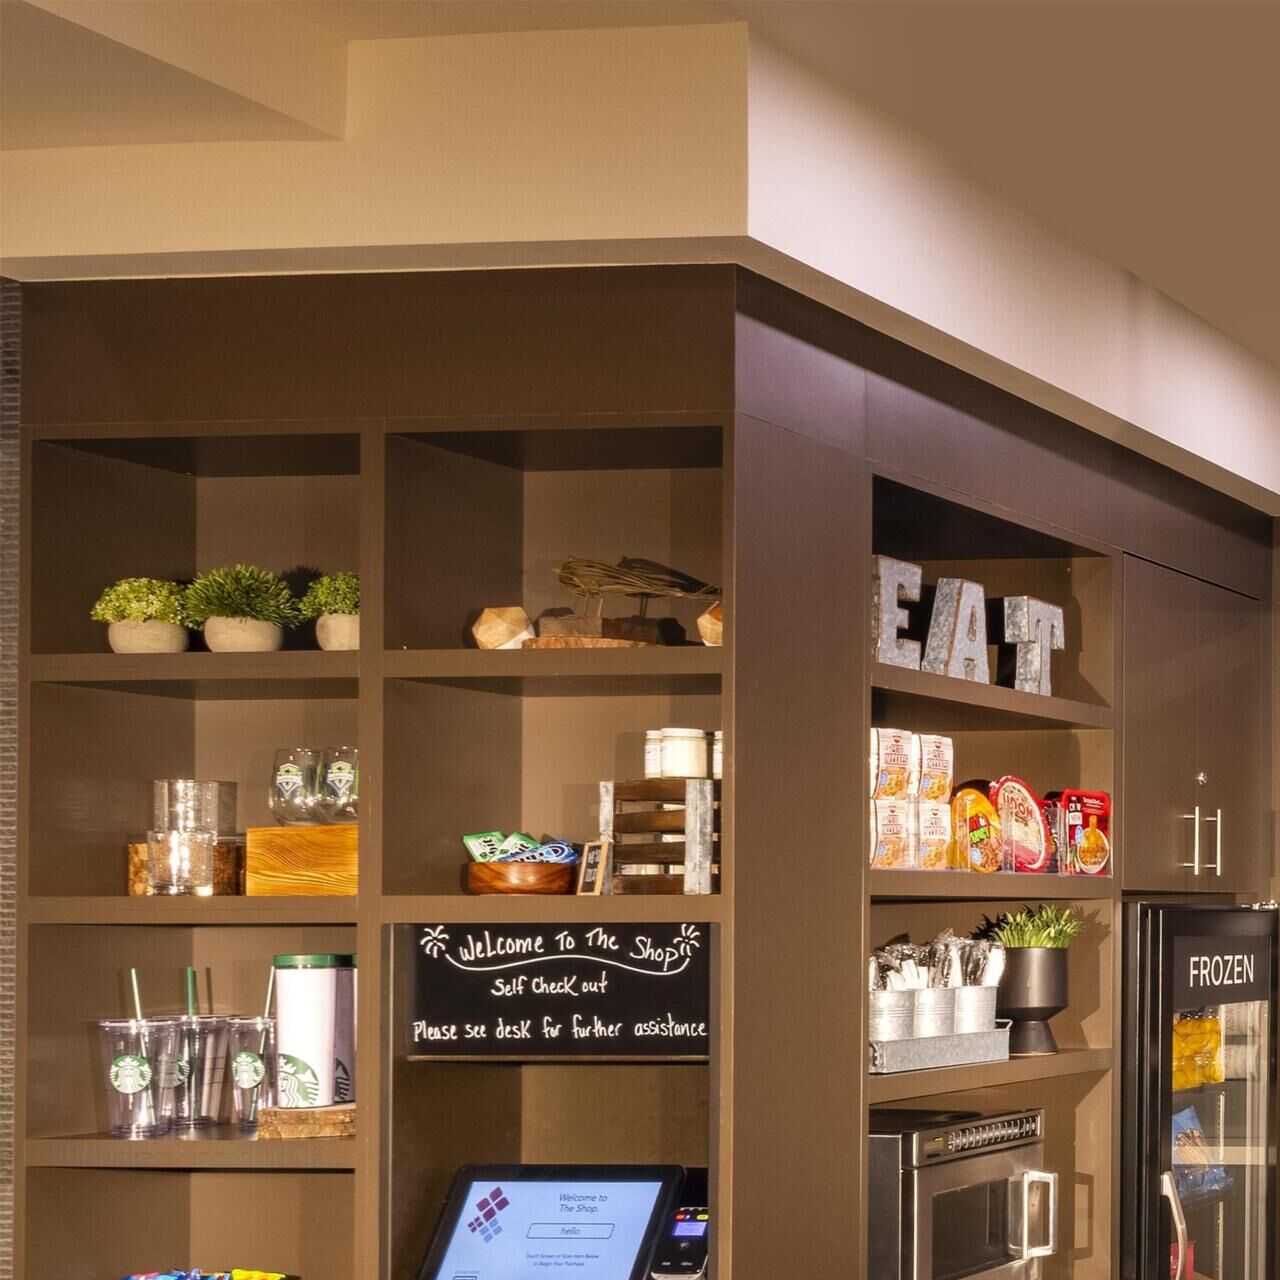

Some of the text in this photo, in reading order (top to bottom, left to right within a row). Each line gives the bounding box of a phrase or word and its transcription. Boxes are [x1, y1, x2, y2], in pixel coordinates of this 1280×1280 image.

[872, 554, 1065, 697] EAT
[585, 928, 619, 950] The
[629, 936, 679, 971] Shop
[491, 976, 527, 996] Self
[582, 971, 608, 993] out
[1189, 954, 1254, 987] FROZEN
[413, 1020, 458, 1041] Please
[465, 1023, 487, 1038] see
[542, 1016, 562, 1038] for
[572, 1014, 622, 1038] further
[634, 1013, 708, 1037] assistance
[559, 1193, 608, 1202] Welcome to
[559, 1204, 574, 1213] The
[560, 1226, 581, 1235] hello
